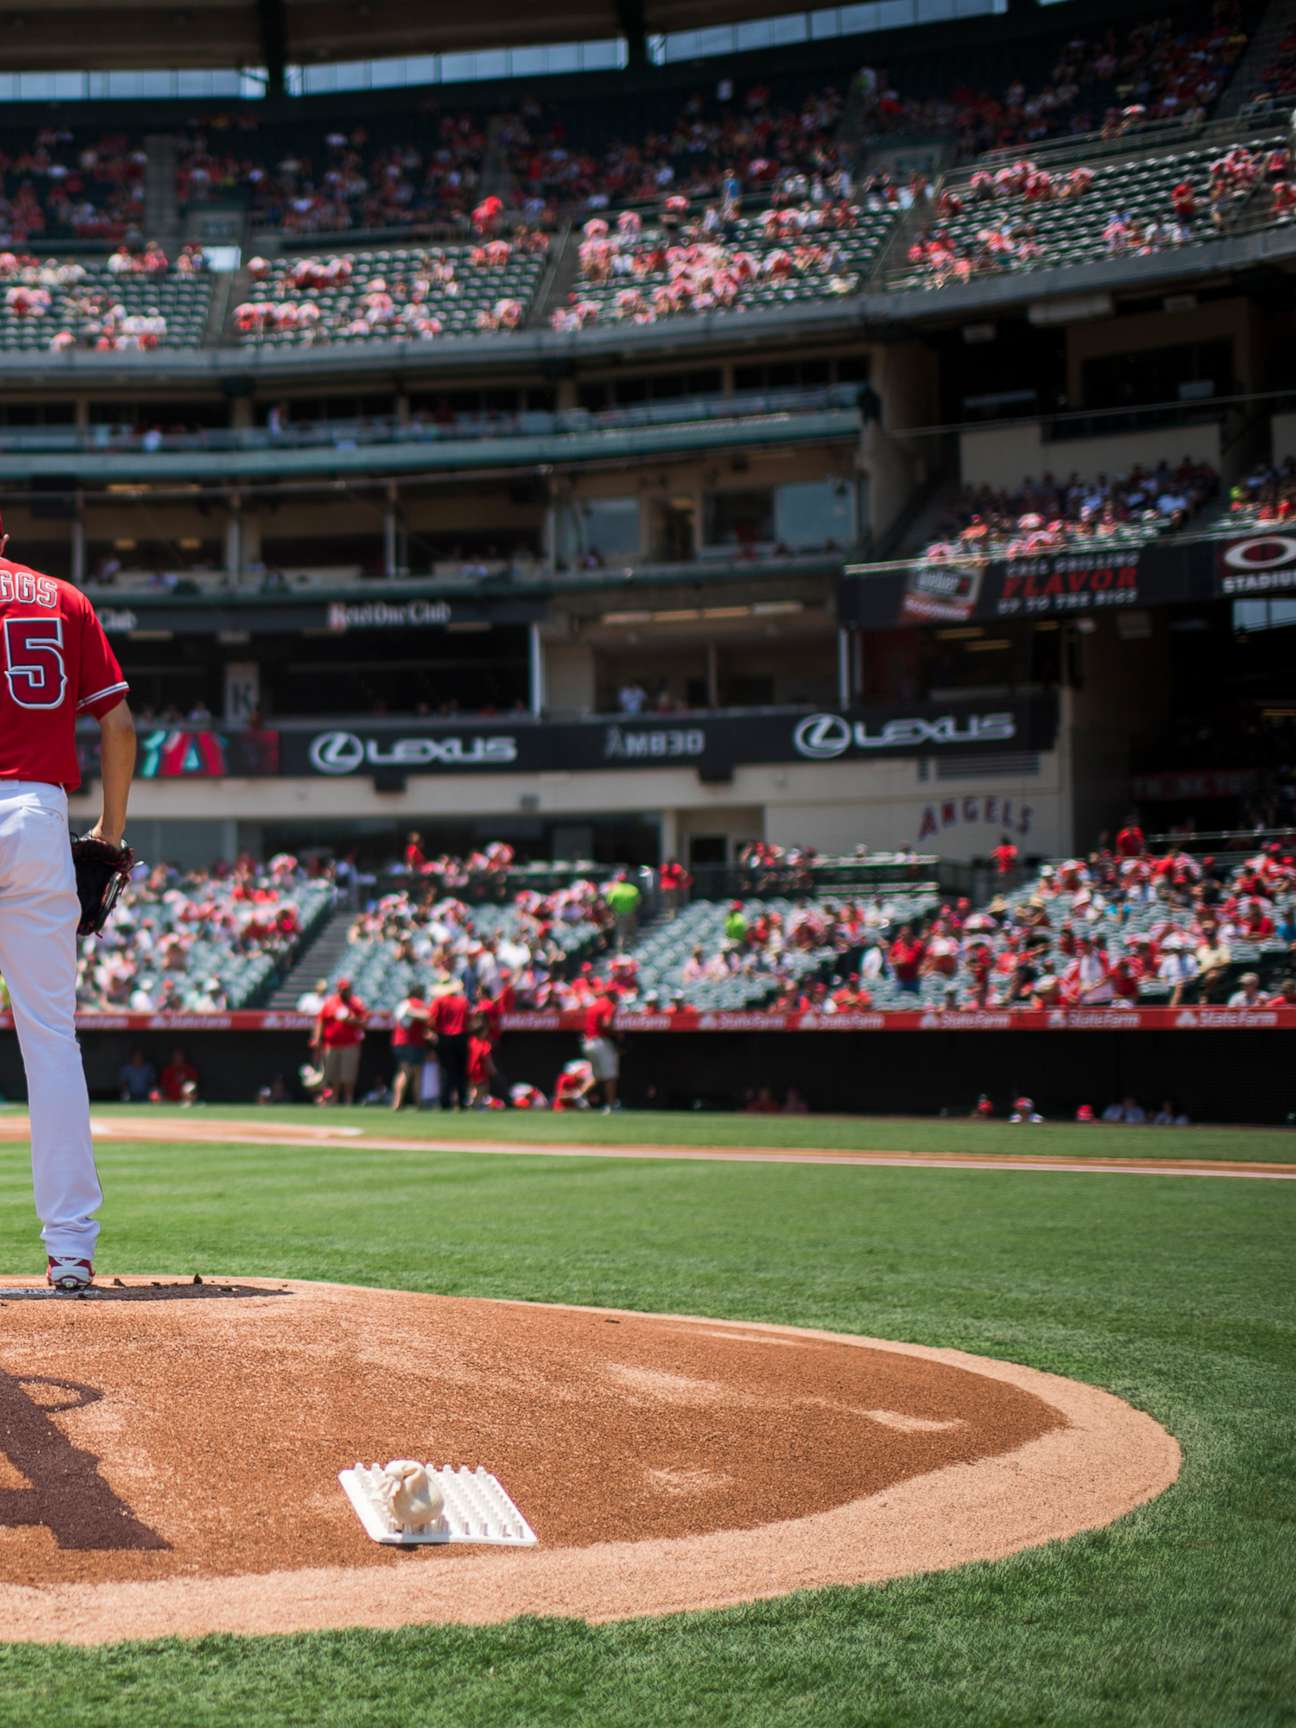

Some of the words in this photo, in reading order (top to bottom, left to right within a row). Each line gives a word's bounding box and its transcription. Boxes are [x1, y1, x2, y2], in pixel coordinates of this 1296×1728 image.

[1001, 566, 1137, 599] FLAVOR
[1222, 568, 1296, 593] STADIU
[855, 712, 1016, 748] LEXUS
[367, 736, 517, 764] LEXUS
[917, 797, 1034, 841] ANGELS
